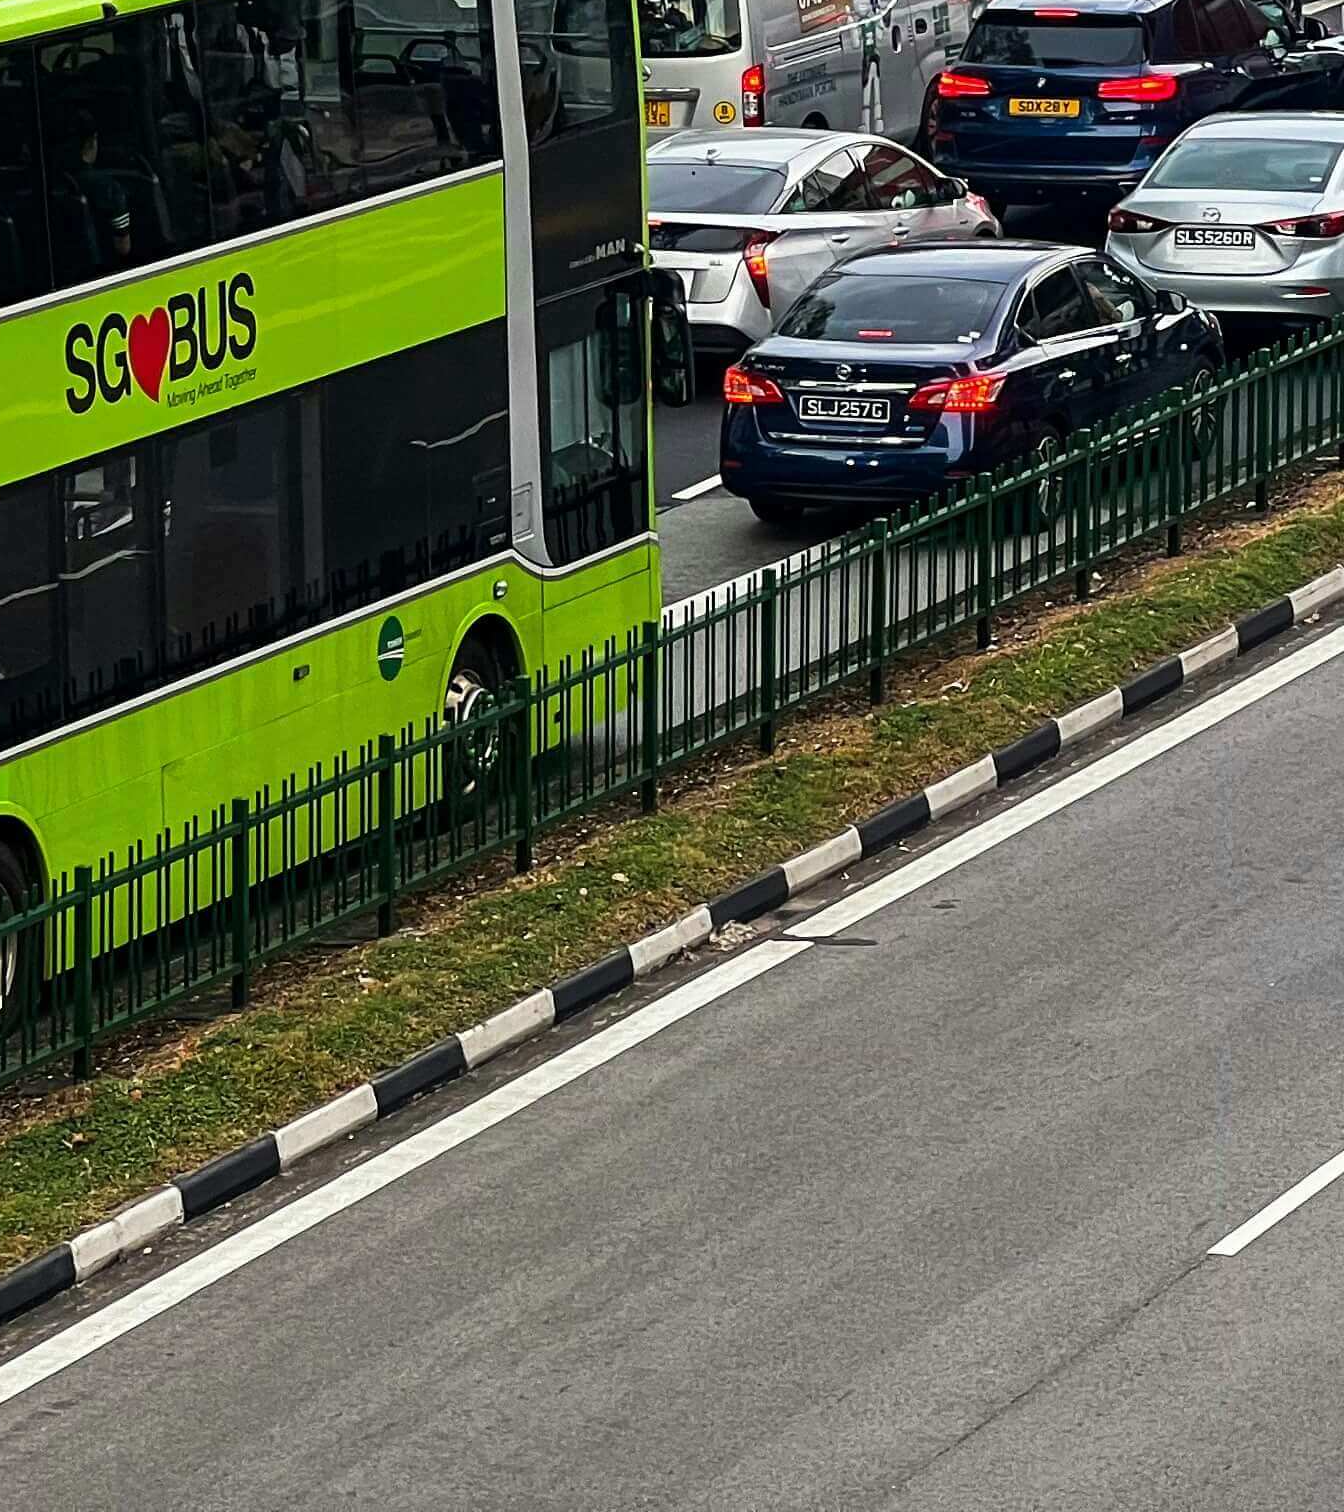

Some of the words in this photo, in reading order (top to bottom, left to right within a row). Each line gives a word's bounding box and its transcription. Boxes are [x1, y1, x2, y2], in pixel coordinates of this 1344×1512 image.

[1176, 230, 1253, 245] SLS5260R
[595, 238, 626, 260] MAN
[807, 399, 883, 418] SLJ257G
